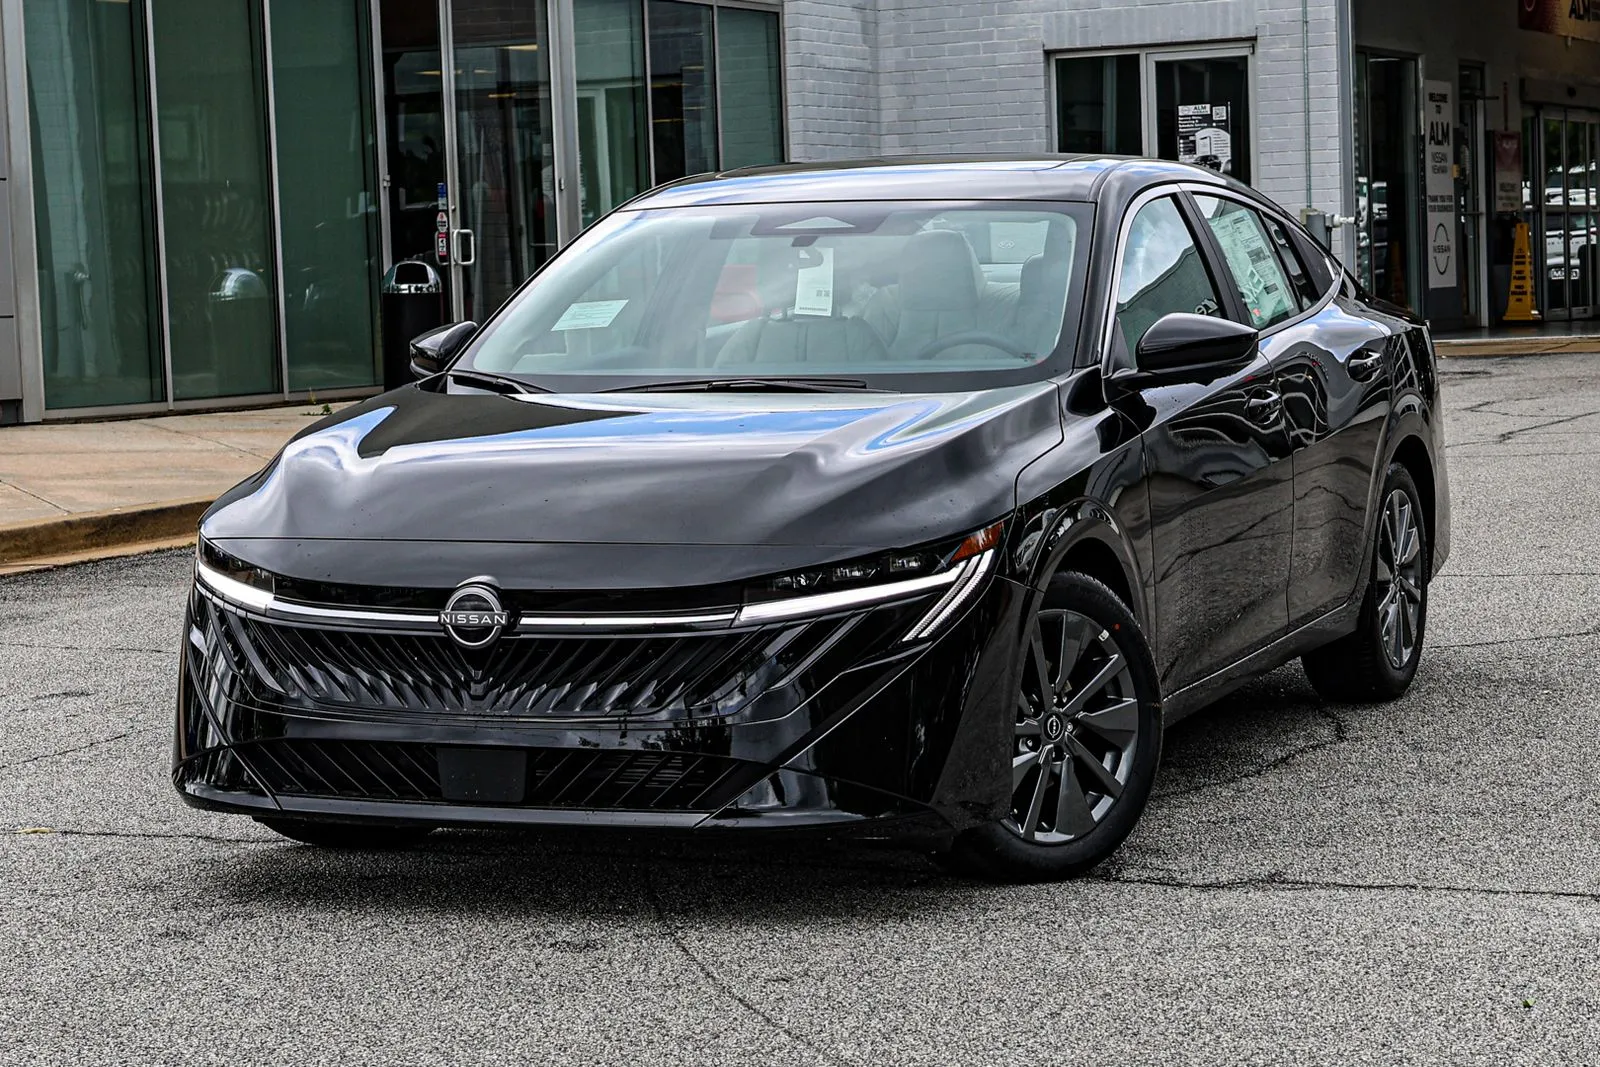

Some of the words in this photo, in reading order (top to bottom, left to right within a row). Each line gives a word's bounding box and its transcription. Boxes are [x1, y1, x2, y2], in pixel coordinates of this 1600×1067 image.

[1429, 121, 1450, 146] ALM
[1433, 245, 1451, 253] NISSAN
[440, 613, 506, 624] NISSAN
